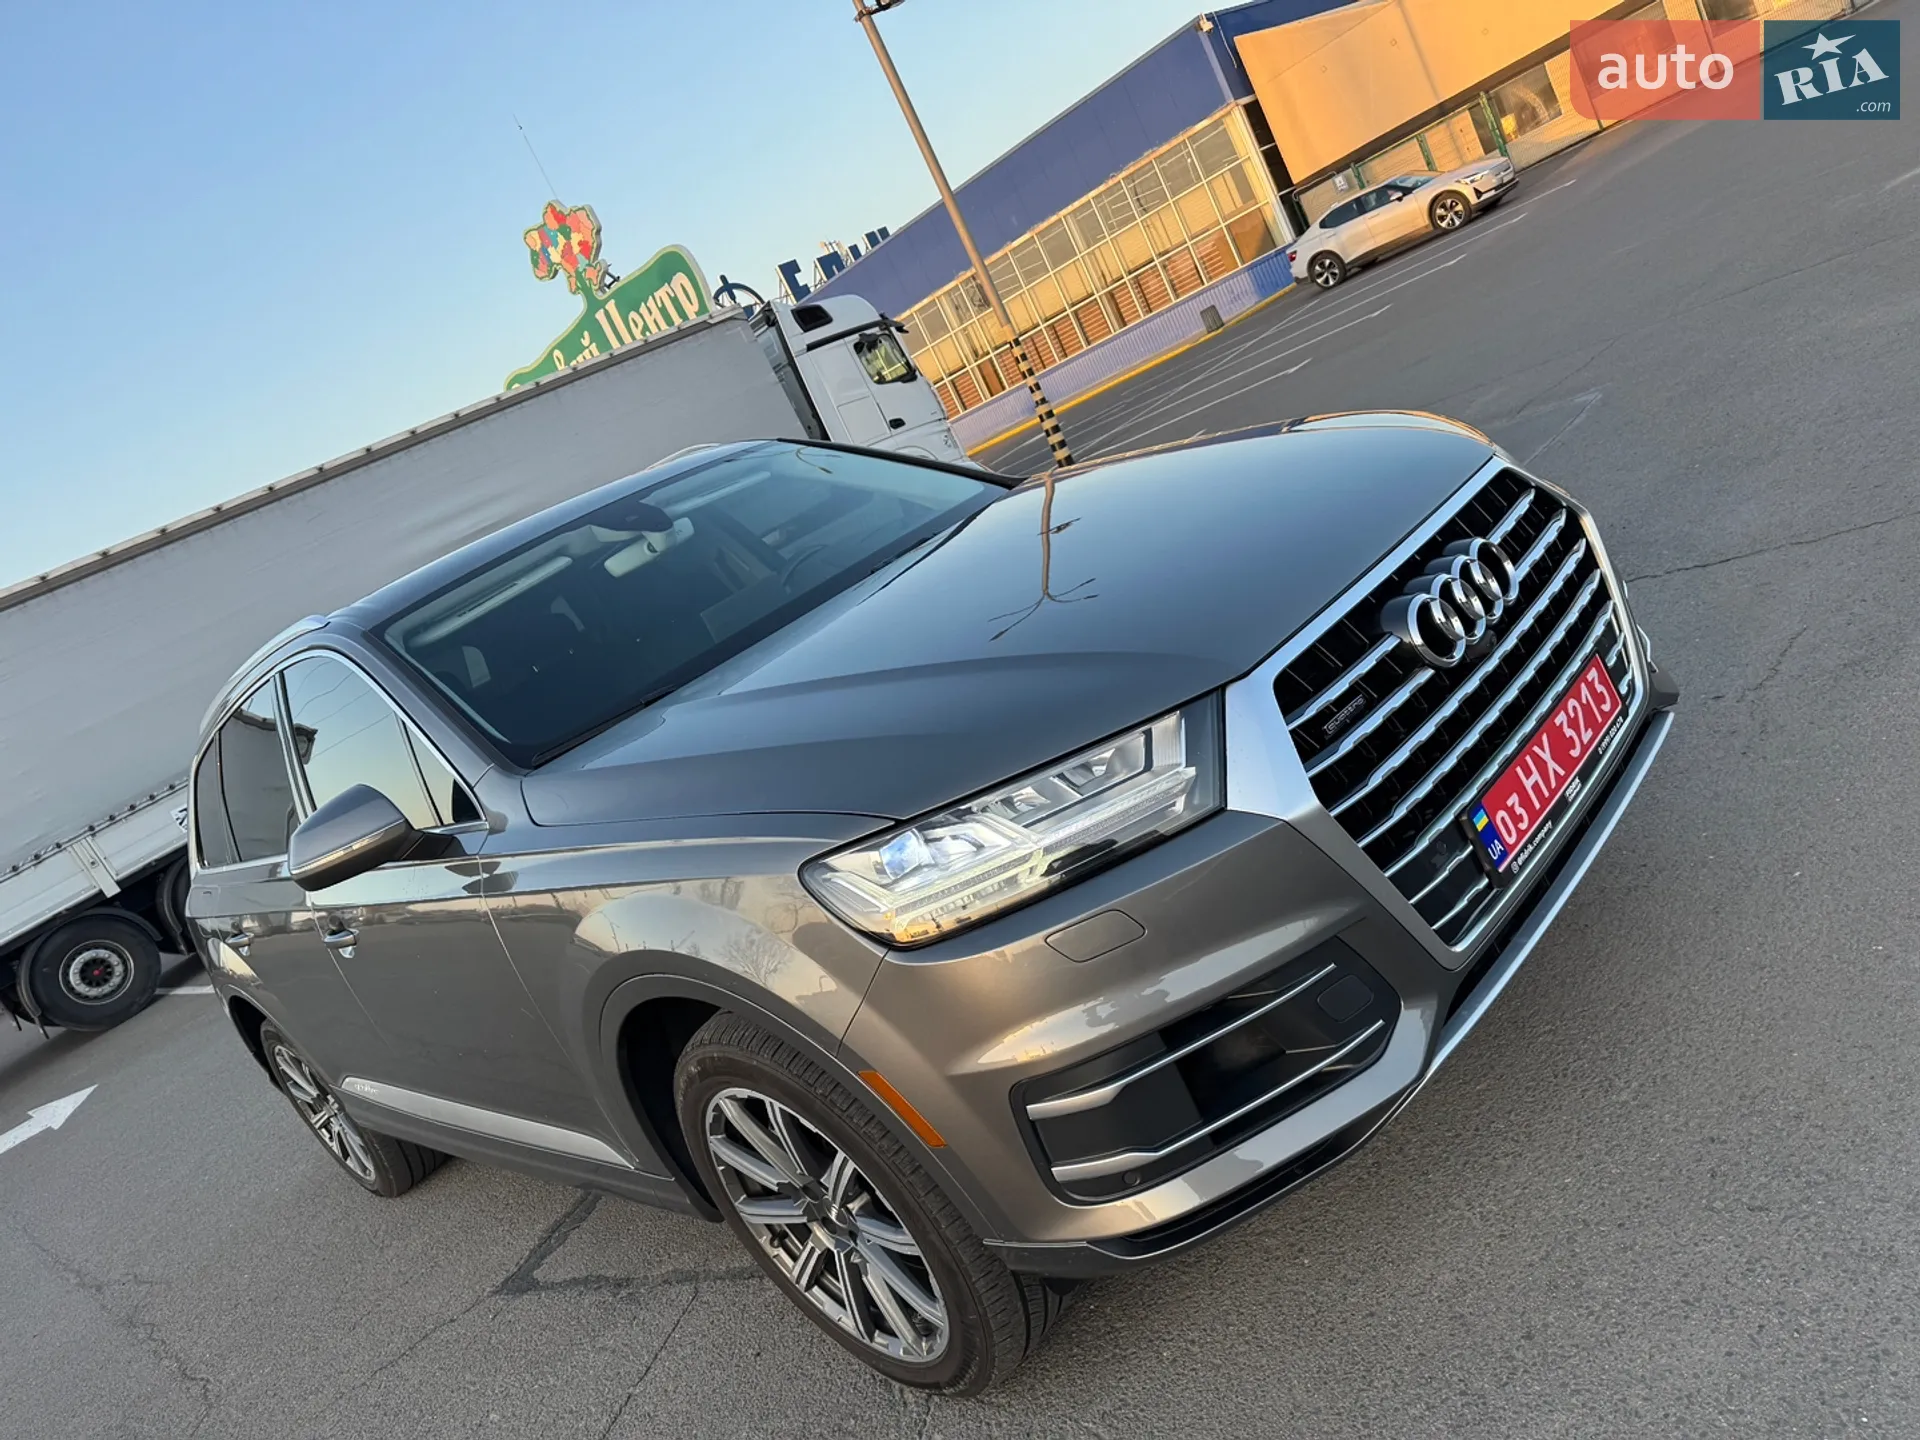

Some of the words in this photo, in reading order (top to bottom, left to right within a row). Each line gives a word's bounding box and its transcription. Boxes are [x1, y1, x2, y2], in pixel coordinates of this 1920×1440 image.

[1495, 792, 1529, 845] 03
[1515, 732, 1565, 810] HX
[1554, 666, 1611, 758] 3213
[1487, 839, 1504, 860] UA
